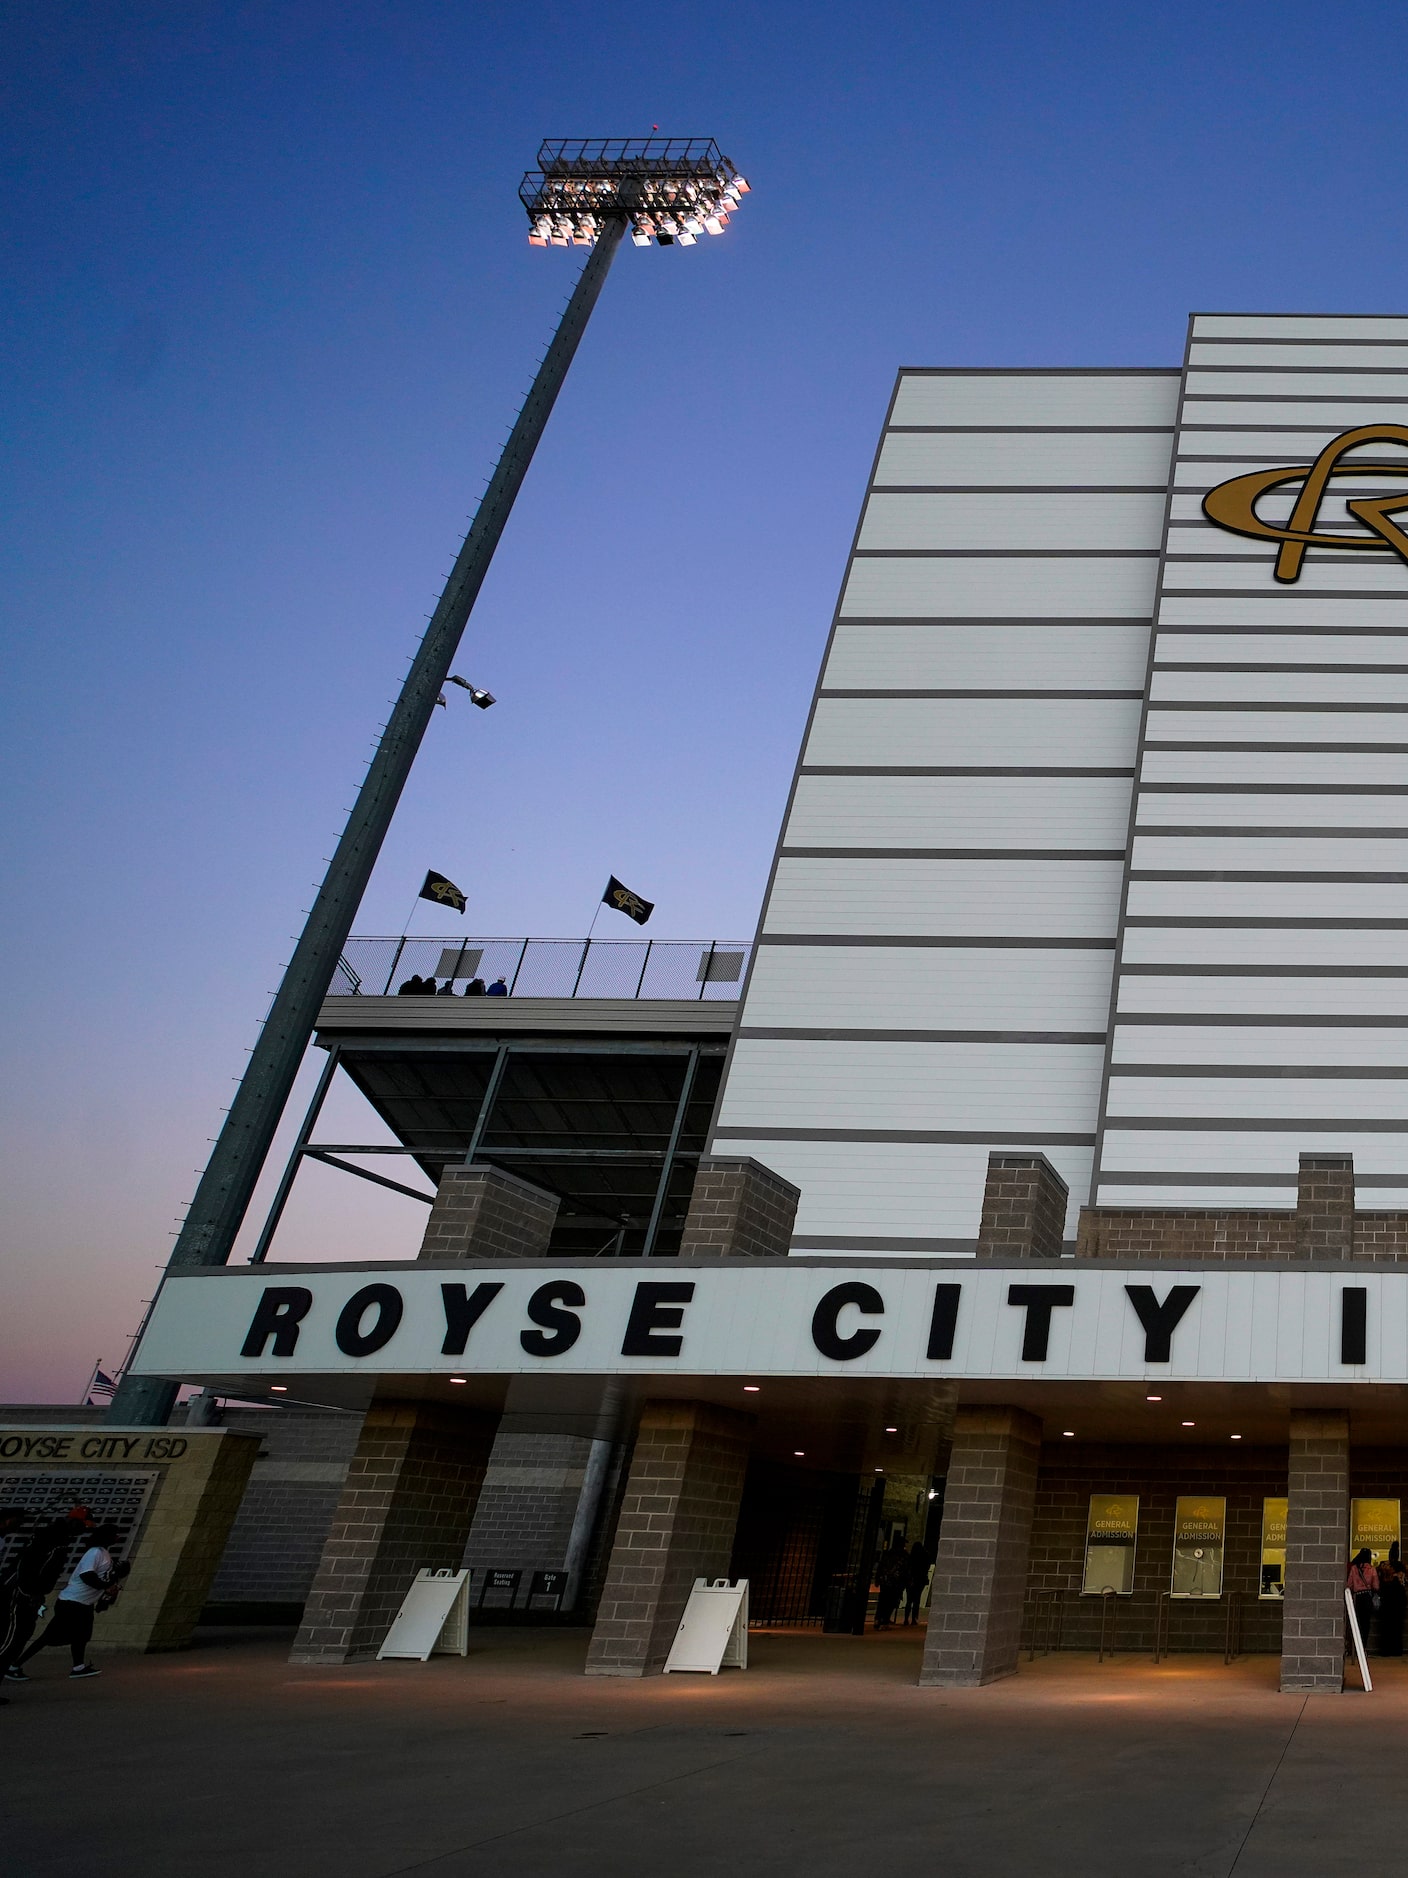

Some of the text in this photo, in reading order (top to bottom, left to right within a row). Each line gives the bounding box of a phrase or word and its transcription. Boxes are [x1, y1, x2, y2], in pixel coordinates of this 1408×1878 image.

[239, 1279, 696, 1358] ROYSE
[812, 1281, 1202, 1363] CITY
[0, 1436, 188, 1459] OYSE CITY ISD
[1095, 1520, 1130, 1529] GENERAL
[1182, 1522, 1218, 1530] GENERAL
[1357, 1524, 1394, 1532] GENERAL
[1090, 1530, 1134, 1539] ADMISSION
[1178, 1532, 1221, 1541] ADMISSION
[1354, 1534, 1398, 1542] ADMISSION
[545, 1582, 551, 1592] 1
